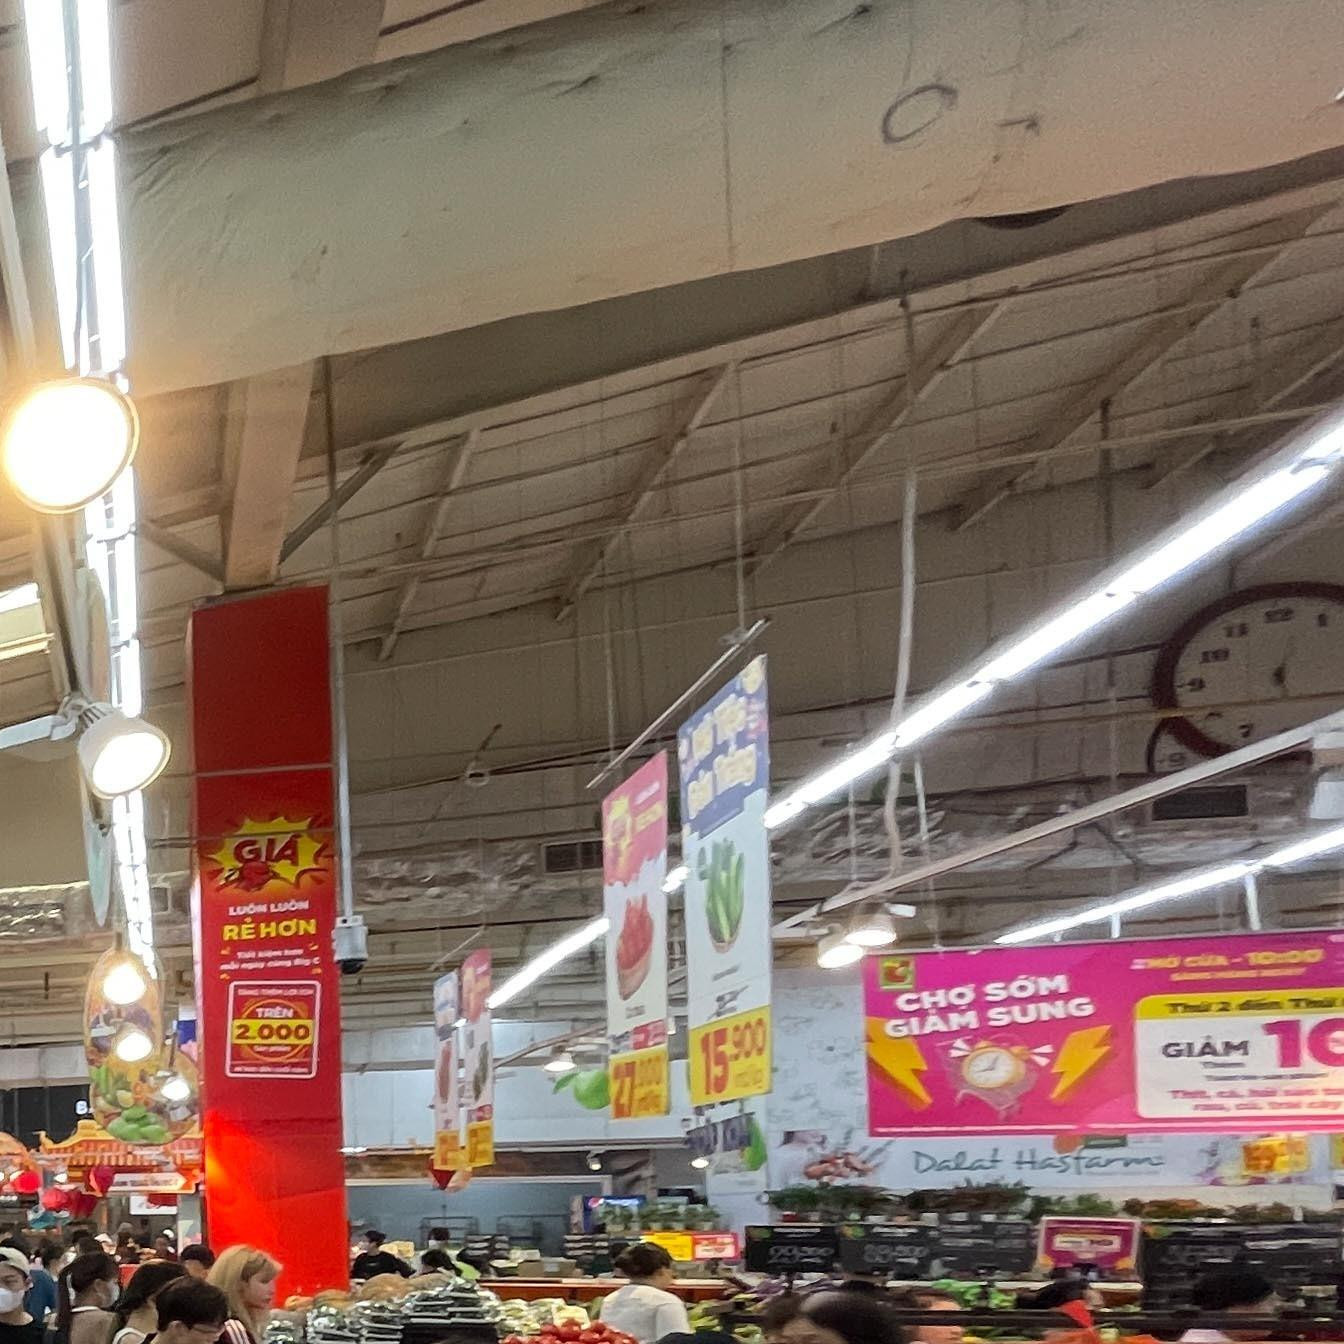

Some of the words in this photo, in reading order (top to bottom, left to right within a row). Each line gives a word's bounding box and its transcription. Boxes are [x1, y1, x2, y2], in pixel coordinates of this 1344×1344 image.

[233, 832, 303, 866] GIÁ
[260, 919, 317, 938] HƠN
[895, 984, 976, 1012] CHỢ
[985, 974, 1069, 1002] SỚM
[234, 1023, 310, 1040] 2.000
[884, 1006, 980, 1038] GIẢM
[987, 997, 1095, 1027] SUNG
[1161, 1034, 1249, 1059] GIẢM
[912, 1147, 1003, 1174] Dalat
[1012, 1147, 1165, 1175] Hasfarm
